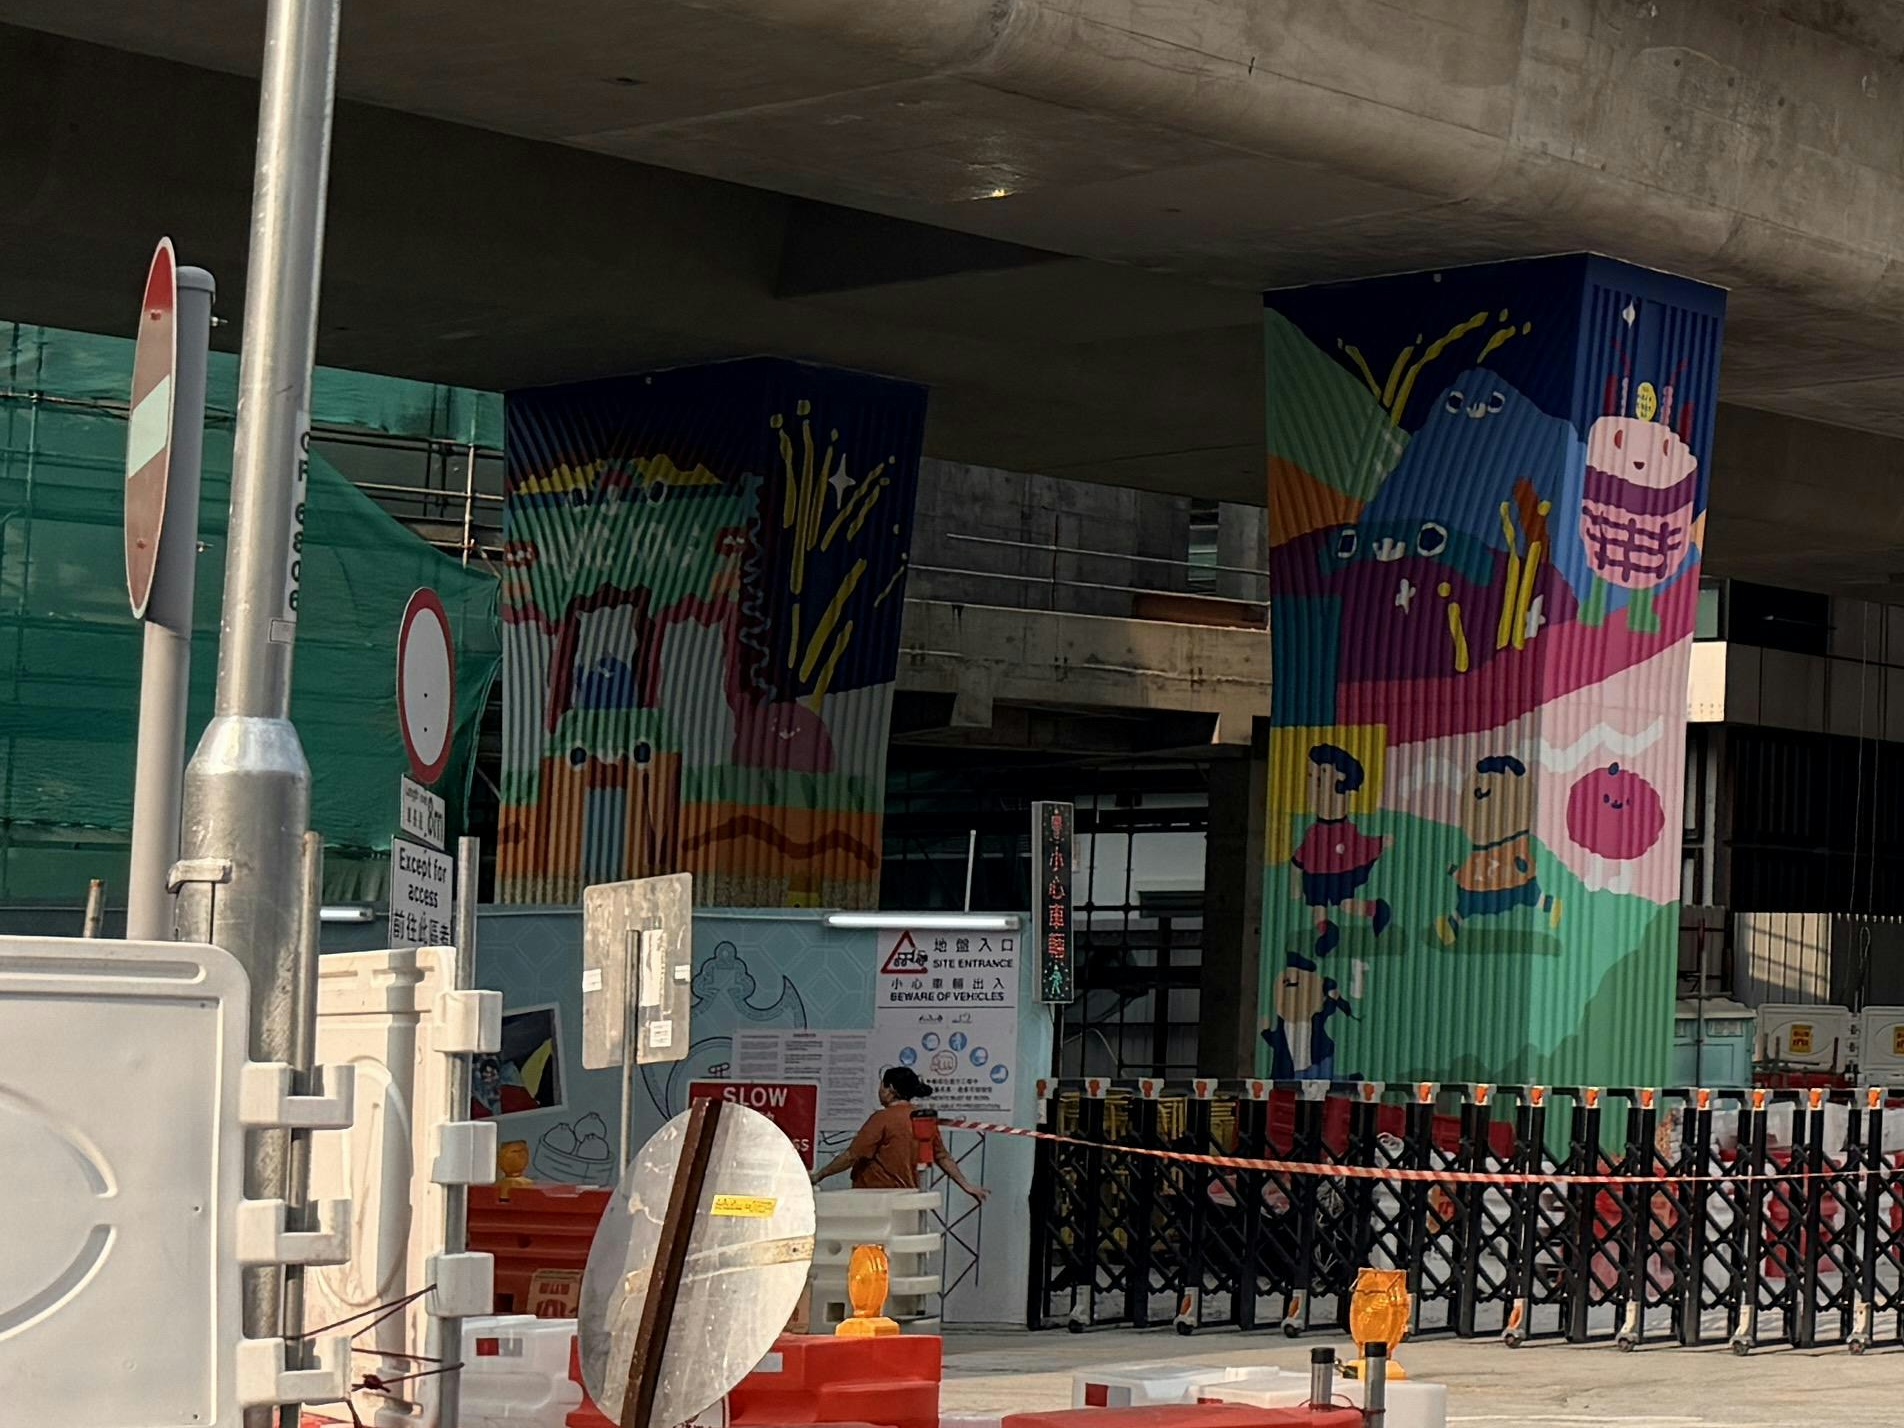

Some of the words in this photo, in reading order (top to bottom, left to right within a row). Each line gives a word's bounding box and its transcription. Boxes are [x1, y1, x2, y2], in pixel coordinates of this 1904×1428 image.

[399, 847, 431, 881] Except
[433, 858, 447, 884] for
[408, 884, 438, 908] access
[933, 937, 1014, 952] 地盤入口
[933, 958, 955, 968] SITE
[958, 958, 1013, 968] ENTRANCE
[890, 992, 934, 1002] BEWARE
[936, 992, 951, 1002] OF
[954, 991, 1005, 1001] VEHICLES
[723, 1087, 788, 1108] SLOW
